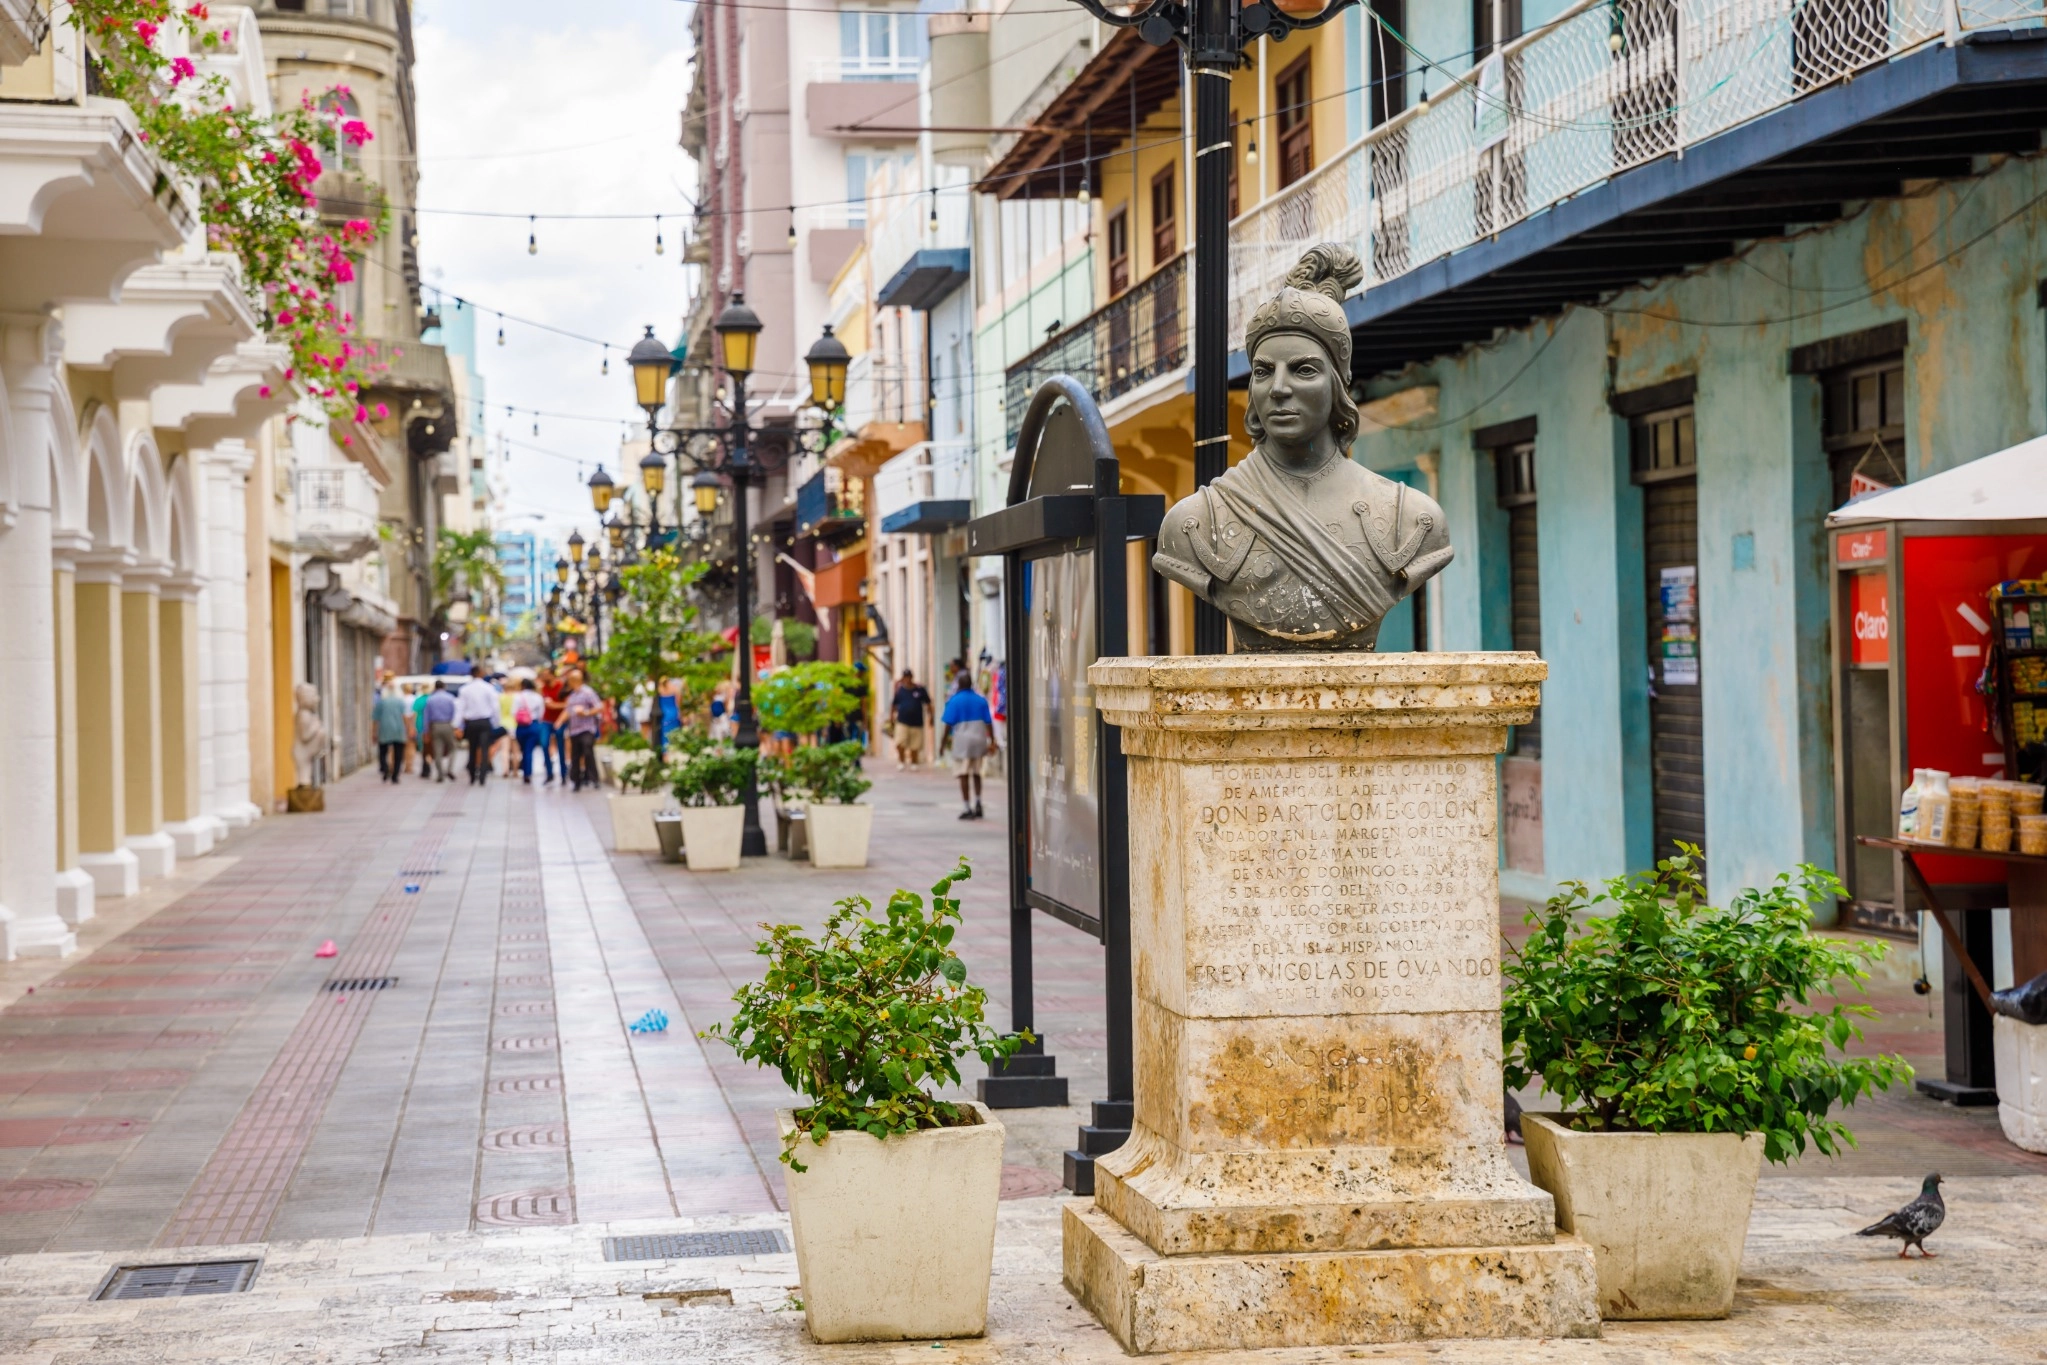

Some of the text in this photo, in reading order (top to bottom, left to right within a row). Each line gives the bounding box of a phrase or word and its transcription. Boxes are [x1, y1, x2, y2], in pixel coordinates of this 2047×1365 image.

[1851, 542, 1869, 558] Claro
[1855, 611, 1888, 639] Claro
[1211, 763, 1467, 781] HOMENAJE DEL PRIMER CABILDO
[1224, 787, 1242, 799] DE
[1325, 785, 1343, 797] AL
[1351, 782, 1457, 796] ADELANTADO
[1202, 805, 1249, 824] DON
[1257, 801, 1396, 823] BARTOLOME
[1402, 799, 1480, 820] COLON
[1195, 825, 1489, 843] FUNDADOR EN LA MARGEN ORIENTAL
[1229, 844, 1454, 862] DEL RIO OZAMA DE LA VILLA
[1233, 868, 1250, 880] DE
[1256, 866, 1310, 880] SANTO
[1318, 864, 1396, 879] DOMINGO
[1402, 864, 1418, 876] EL
[1229, 887, 1237, 899] 5
[1244, 886, 1261, 899] DE
[1268, 884, 1333, 898] AGOSTO
[1339, 884, 1366, 897] DEL
[1372, 880, 1408, 896] AÑO
[1222, 902, 1464, 918] PARA LUEGO SER TRASLADADA
[1219, 925, 1256, 937] ESTA
[1264, 923, 1312, 936] PARTE
[1320, 922, 1348, 935] POR
[1356, 922, 1373, 934] EL
[1379, 919, 1487, 934] GOBERNADOR
[1253, 943, 1271, 955] DE
[1277, 942, 1295, 954] LA
[1303, 942, 1335, 954] ISLA
[1194, 957, 1493, 983] FREY NICOLAS DE OVANDO
[1276, 984, 1414, 999] EN EL AÑO 1502
